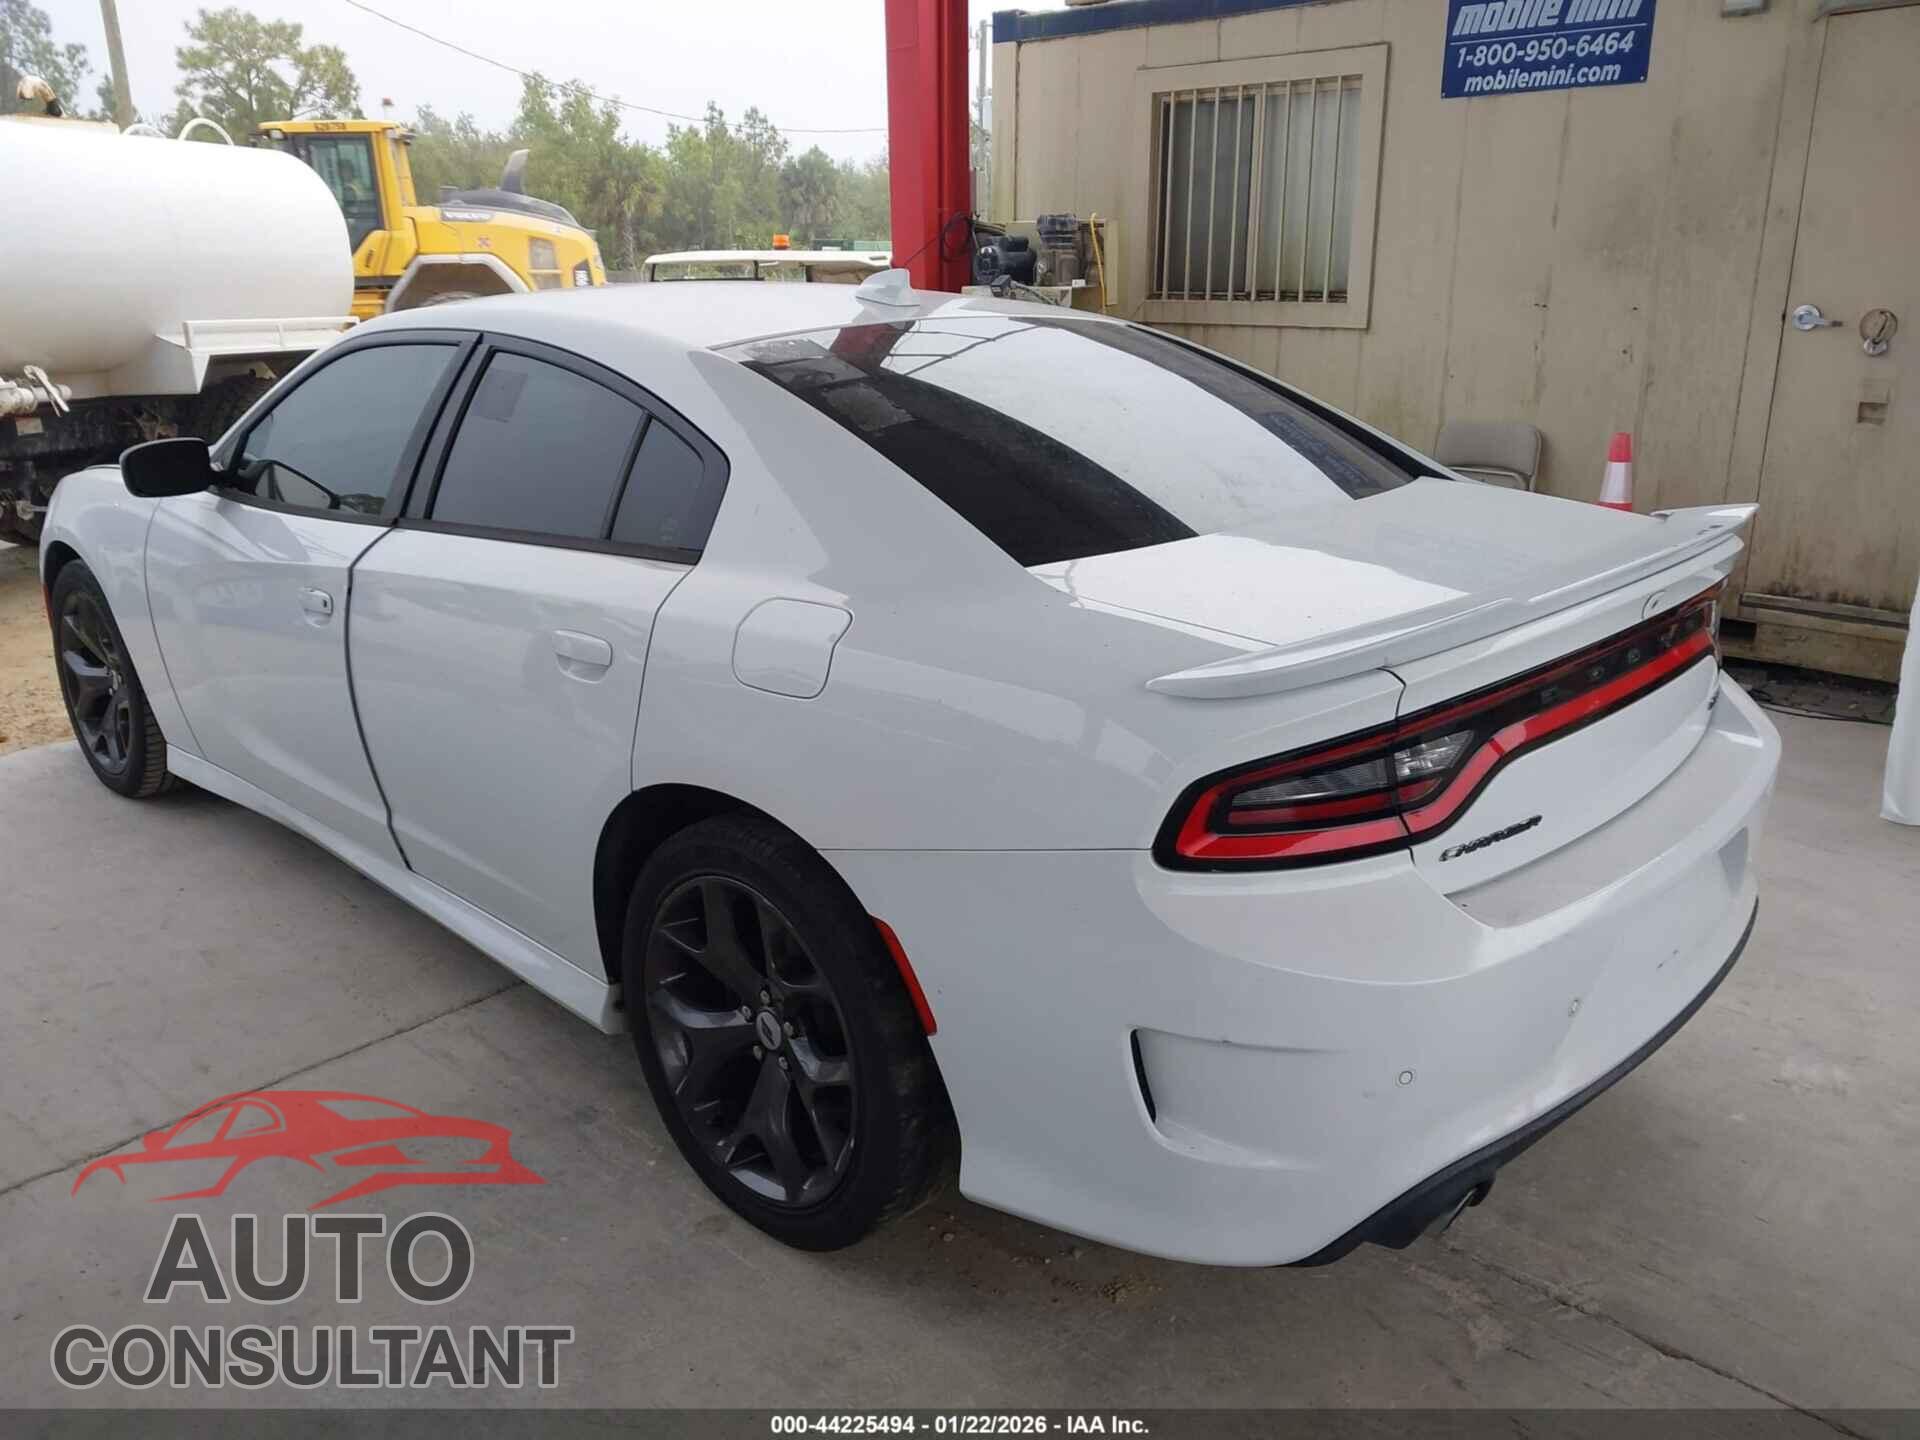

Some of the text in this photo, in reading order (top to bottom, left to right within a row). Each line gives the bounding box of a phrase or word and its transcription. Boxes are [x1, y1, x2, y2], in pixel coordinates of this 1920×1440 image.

[1453, 0, 1563, 36] mobile
[1457, 31, 1635, 68] 1-800-950-6464
[1464, 64, 1621, 92] mobilemini.com
